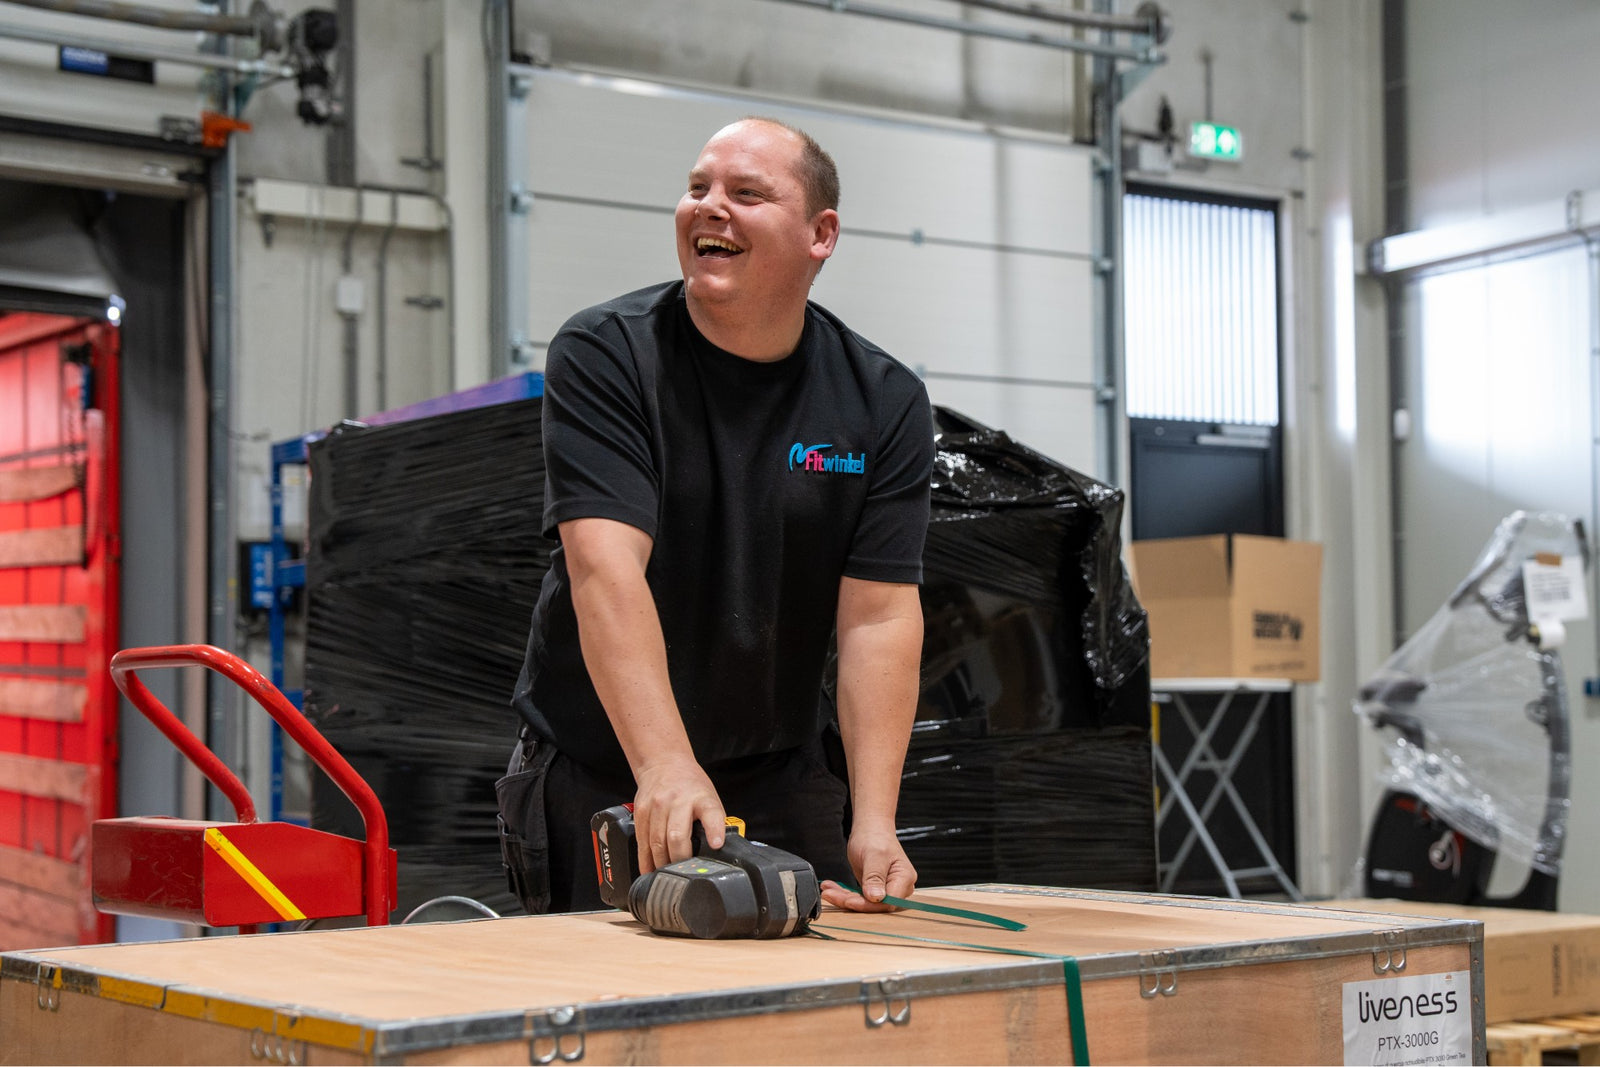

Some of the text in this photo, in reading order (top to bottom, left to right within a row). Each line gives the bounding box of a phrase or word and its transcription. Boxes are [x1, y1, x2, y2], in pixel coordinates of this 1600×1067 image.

[805, 450, 865, 474] Fitwinkel
[603, 848, 611, 867] 18V
[1359, 991, 1457, 1023] liveness
[1378, 1031, 1439, 1051] PTX-3000G
